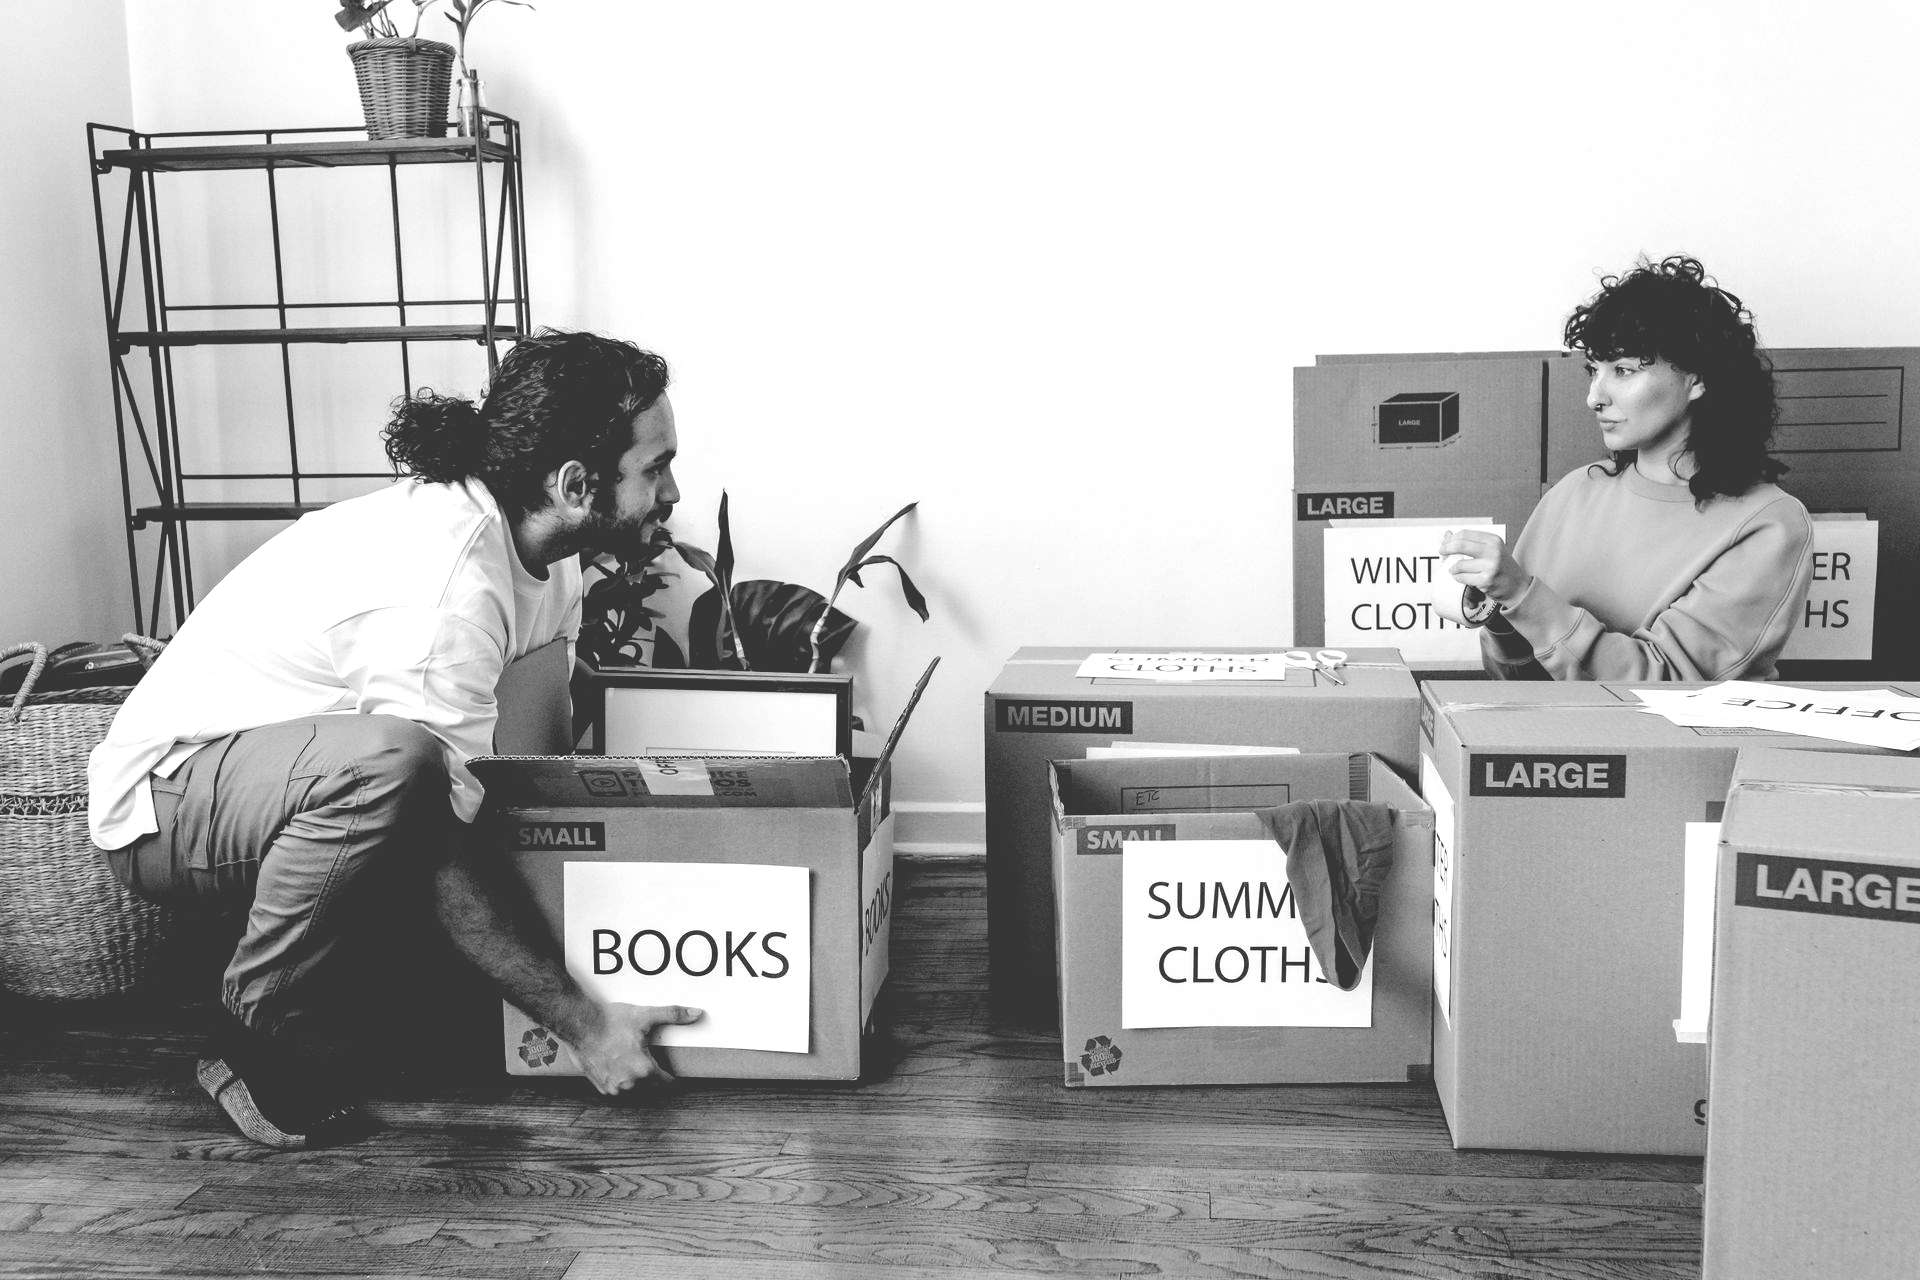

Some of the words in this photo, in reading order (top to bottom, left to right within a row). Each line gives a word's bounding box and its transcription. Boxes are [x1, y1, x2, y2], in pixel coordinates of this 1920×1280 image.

[1307, 497, 1384, 515] LARGE
[1351, 557, 1440, 584] WINT
[1351, 603, 1470, 630] CLOT
[1109, 664, 1258, 673] CLOTHS
[1008, 706, 1121, 727] MEDIUM
[1486, 762, 1609, 789] LARGE
[1136, 789, 1160, 806] ETC
[519, 827, 597, 845] SMALL
[1148, 881, 1296, 920] SUMM
[1756, 864, 1920, 912] LARGE
[865, 871, 891, 957] BOOKS
[592, 929, 789, 979] BOOKS
[1158, 946, 1328, 984] CLOTH
